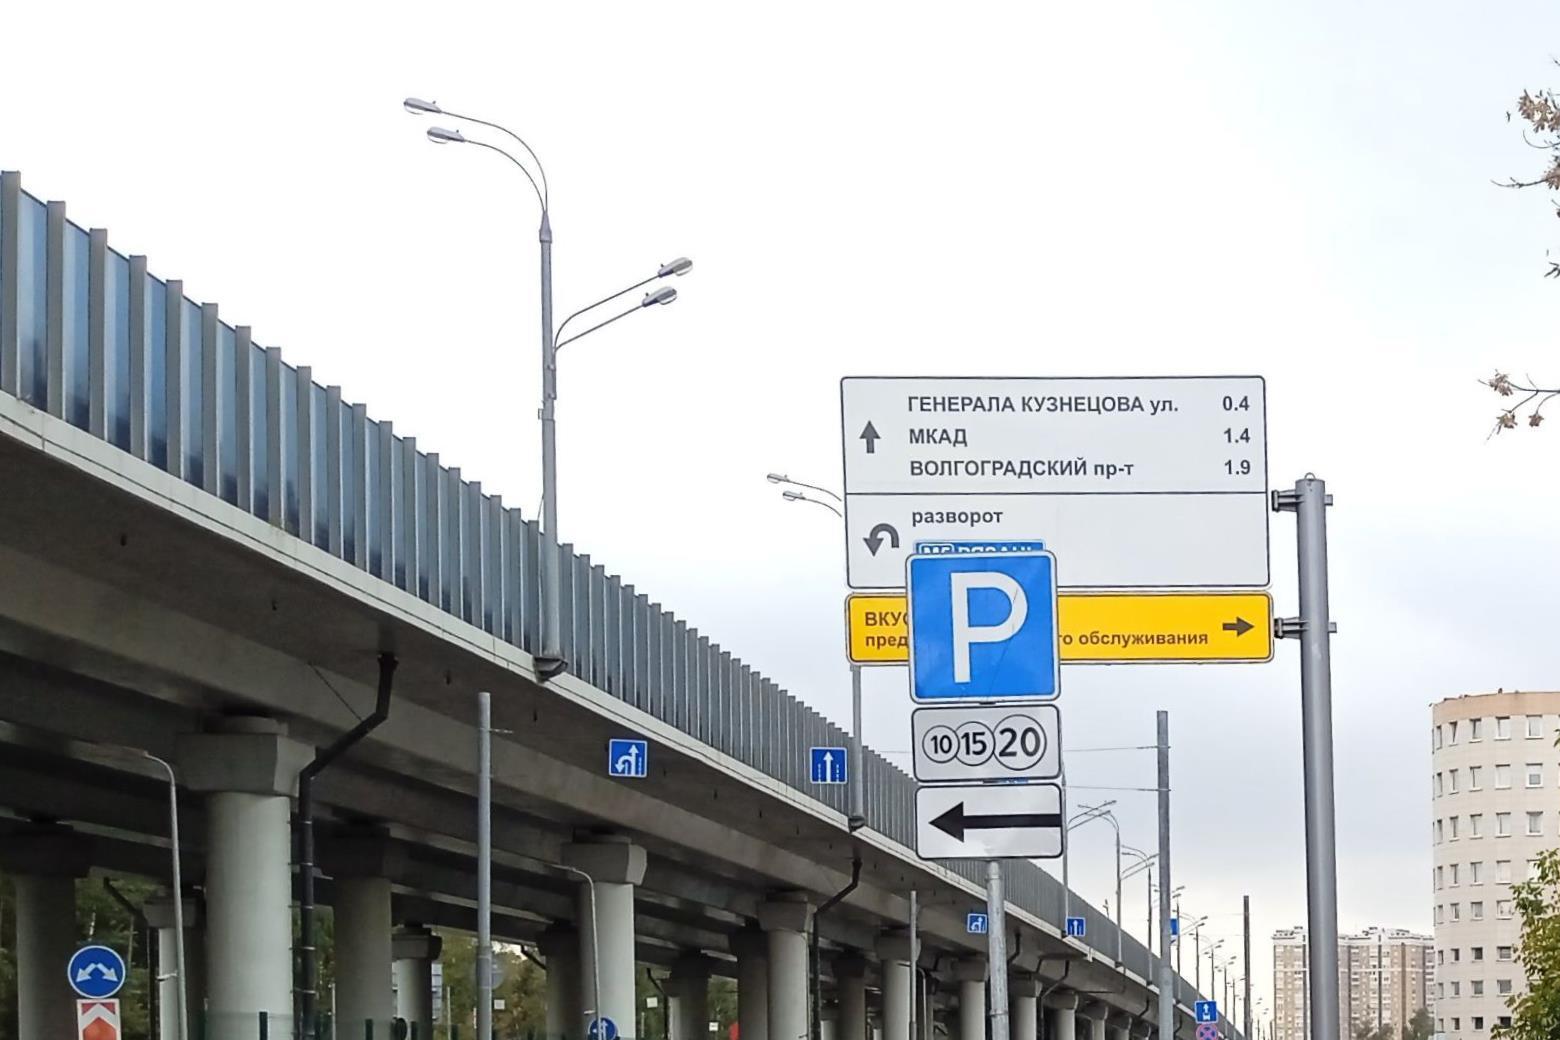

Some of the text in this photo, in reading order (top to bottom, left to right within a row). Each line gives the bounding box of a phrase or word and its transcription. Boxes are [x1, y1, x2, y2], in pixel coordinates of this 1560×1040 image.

[908, 395, 1250, 415] ГЕНЕРАЛА КУЗНЕЦОВА ул. 0.4
[909, 427, 1250, 447] МКАД 1.4
[910, 457, 1251, 479] ВОЛГОГРАДСКИЙ пр-т 1.9
[911, 511, 1003, 527] разворот
[1078, 631, 1208, 648] обслуживания
[930, 726, 1041, 758] 10 15 20
